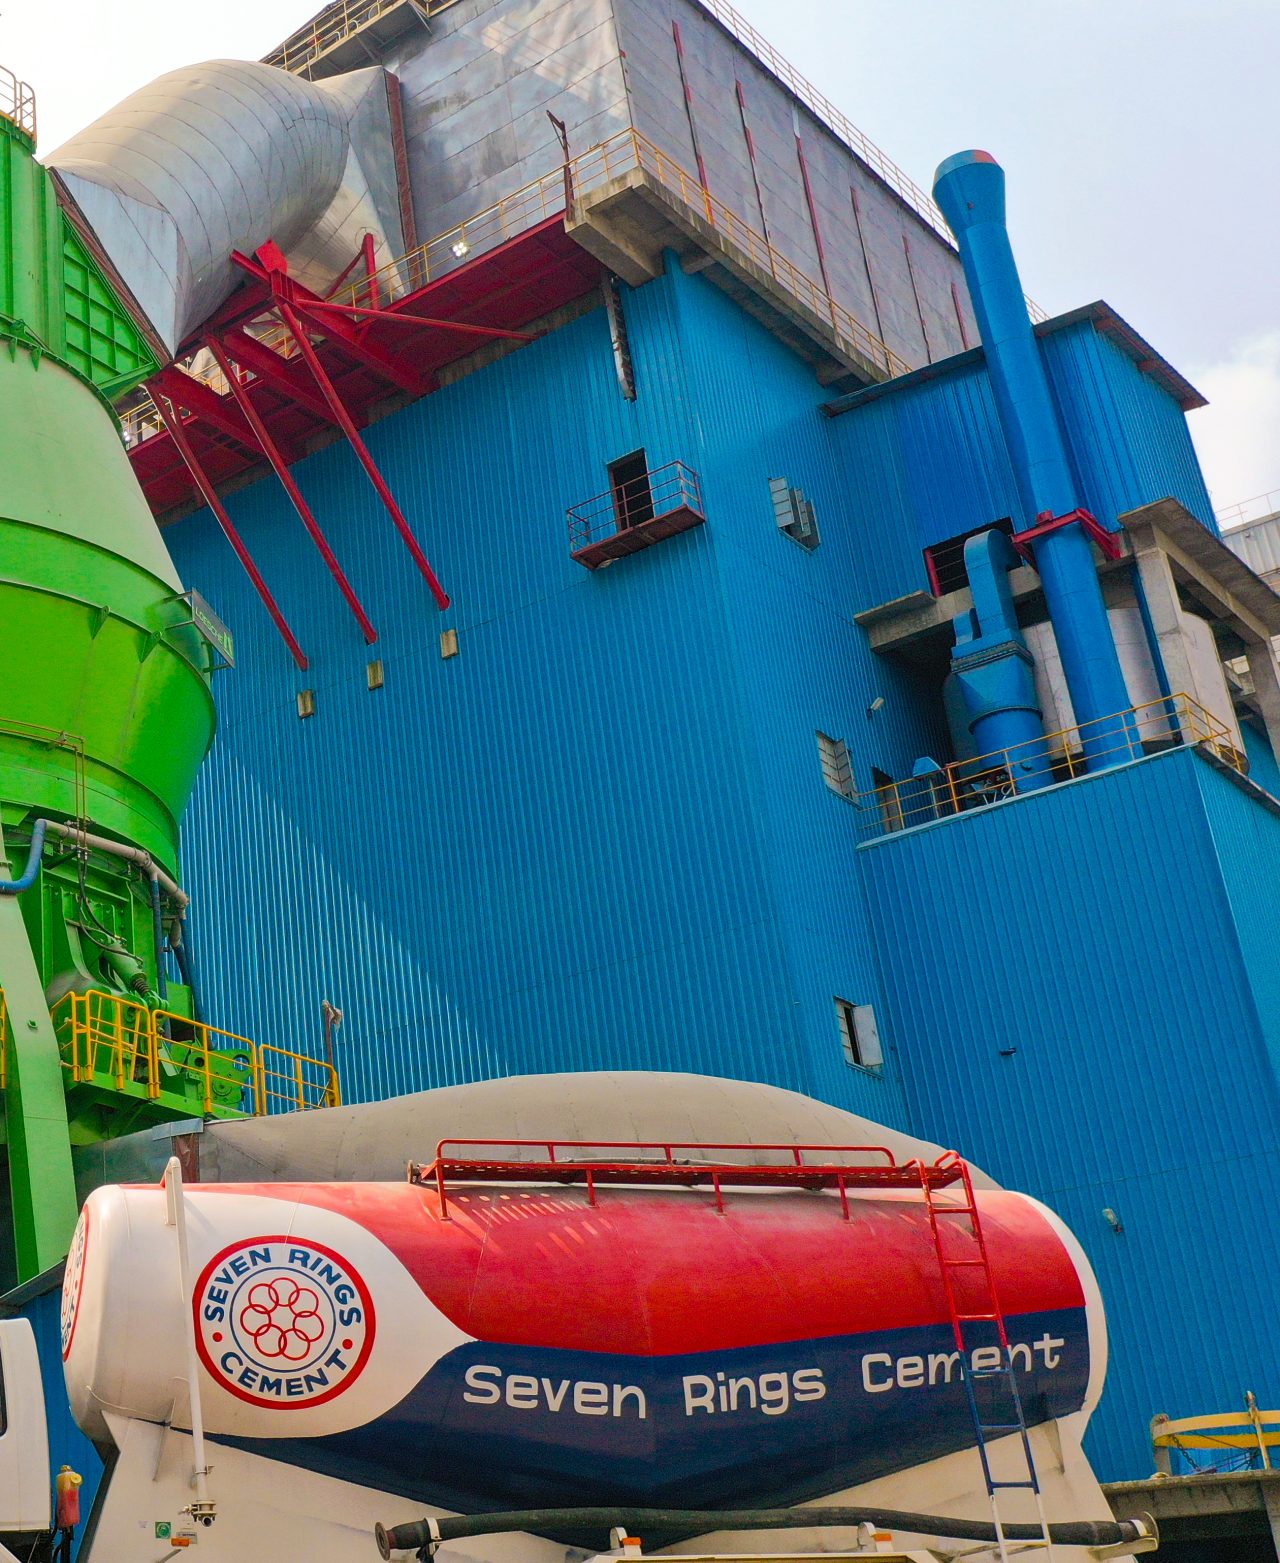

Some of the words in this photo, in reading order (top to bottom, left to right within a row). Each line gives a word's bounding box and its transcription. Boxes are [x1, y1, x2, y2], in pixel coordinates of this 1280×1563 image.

[204, 1247, 272, 1324] SEVEN
[288, 1248, 362, 1327] RINGS
[220, 1347, 348, 1397] CEMENT
[463, 1364, 647, 1419] Seven
[682, 1368, 827, 1416] Rings
[861, 1332, 1065, 1393] Cement
